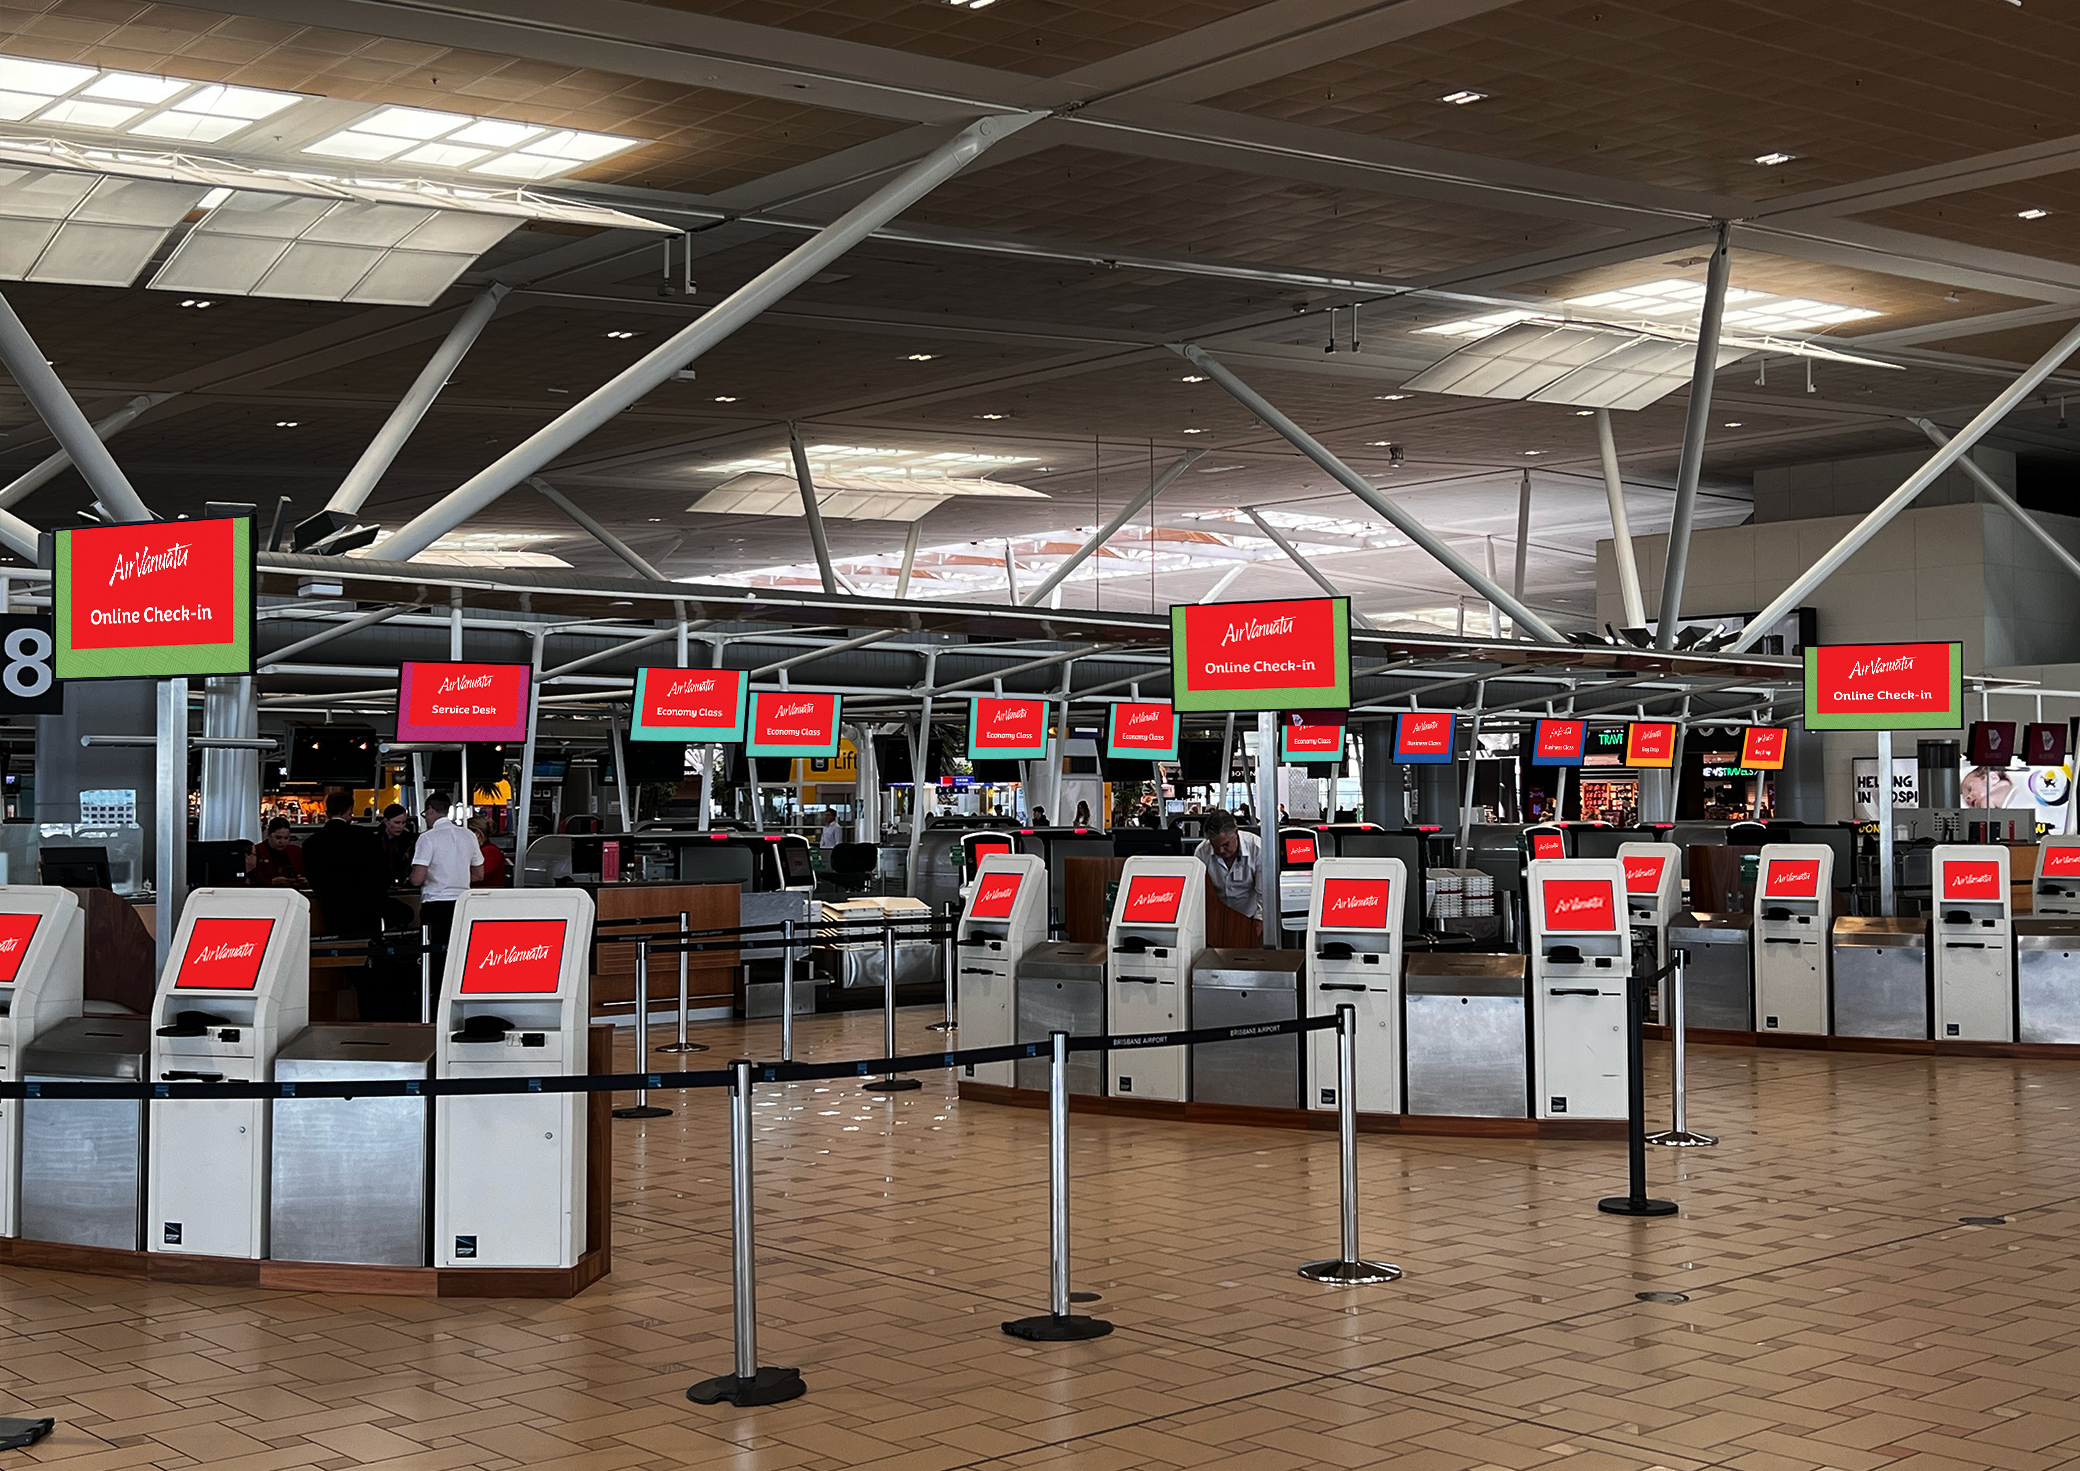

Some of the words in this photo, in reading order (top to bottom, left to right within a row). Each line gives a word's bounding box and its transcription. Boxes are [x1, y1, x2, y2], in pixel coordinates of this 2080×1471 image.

[90, 607, 140, 625] Online
[143, 603, 213, 623] Check-in
[3, 628, 52, 698] 8
[1204, 661, 1251, 675] Online
[1252, 659, 1316, 674] Check-in
[1833, 690, 1875, 702] Online
[1876, 689, 1933, 701] Check-in
[431, 704, 470, 715] Service
[471, 705, 497, 715] Desk
[656, 706, 698, 719] Economy
[698, 708, 723, 718] Class
[766, 727, 801, 738] Economy
[800, 728, 821, 737] Class
[986, 731, 1016, 742] Economy
[1015, 732, 1033, 741] Class
[1857, 775, 1913, 788] HELNG
[1857, 791, 1871, 804] IN
[1230, 1027, 1256, 1037] BRISBANE
[1257, 1025, 1281, 1034] AIRPORT
[1113, 1038, 1142, 1046] BRISBANE
[1142, 1036, 1168, 1044] AIRPORT
